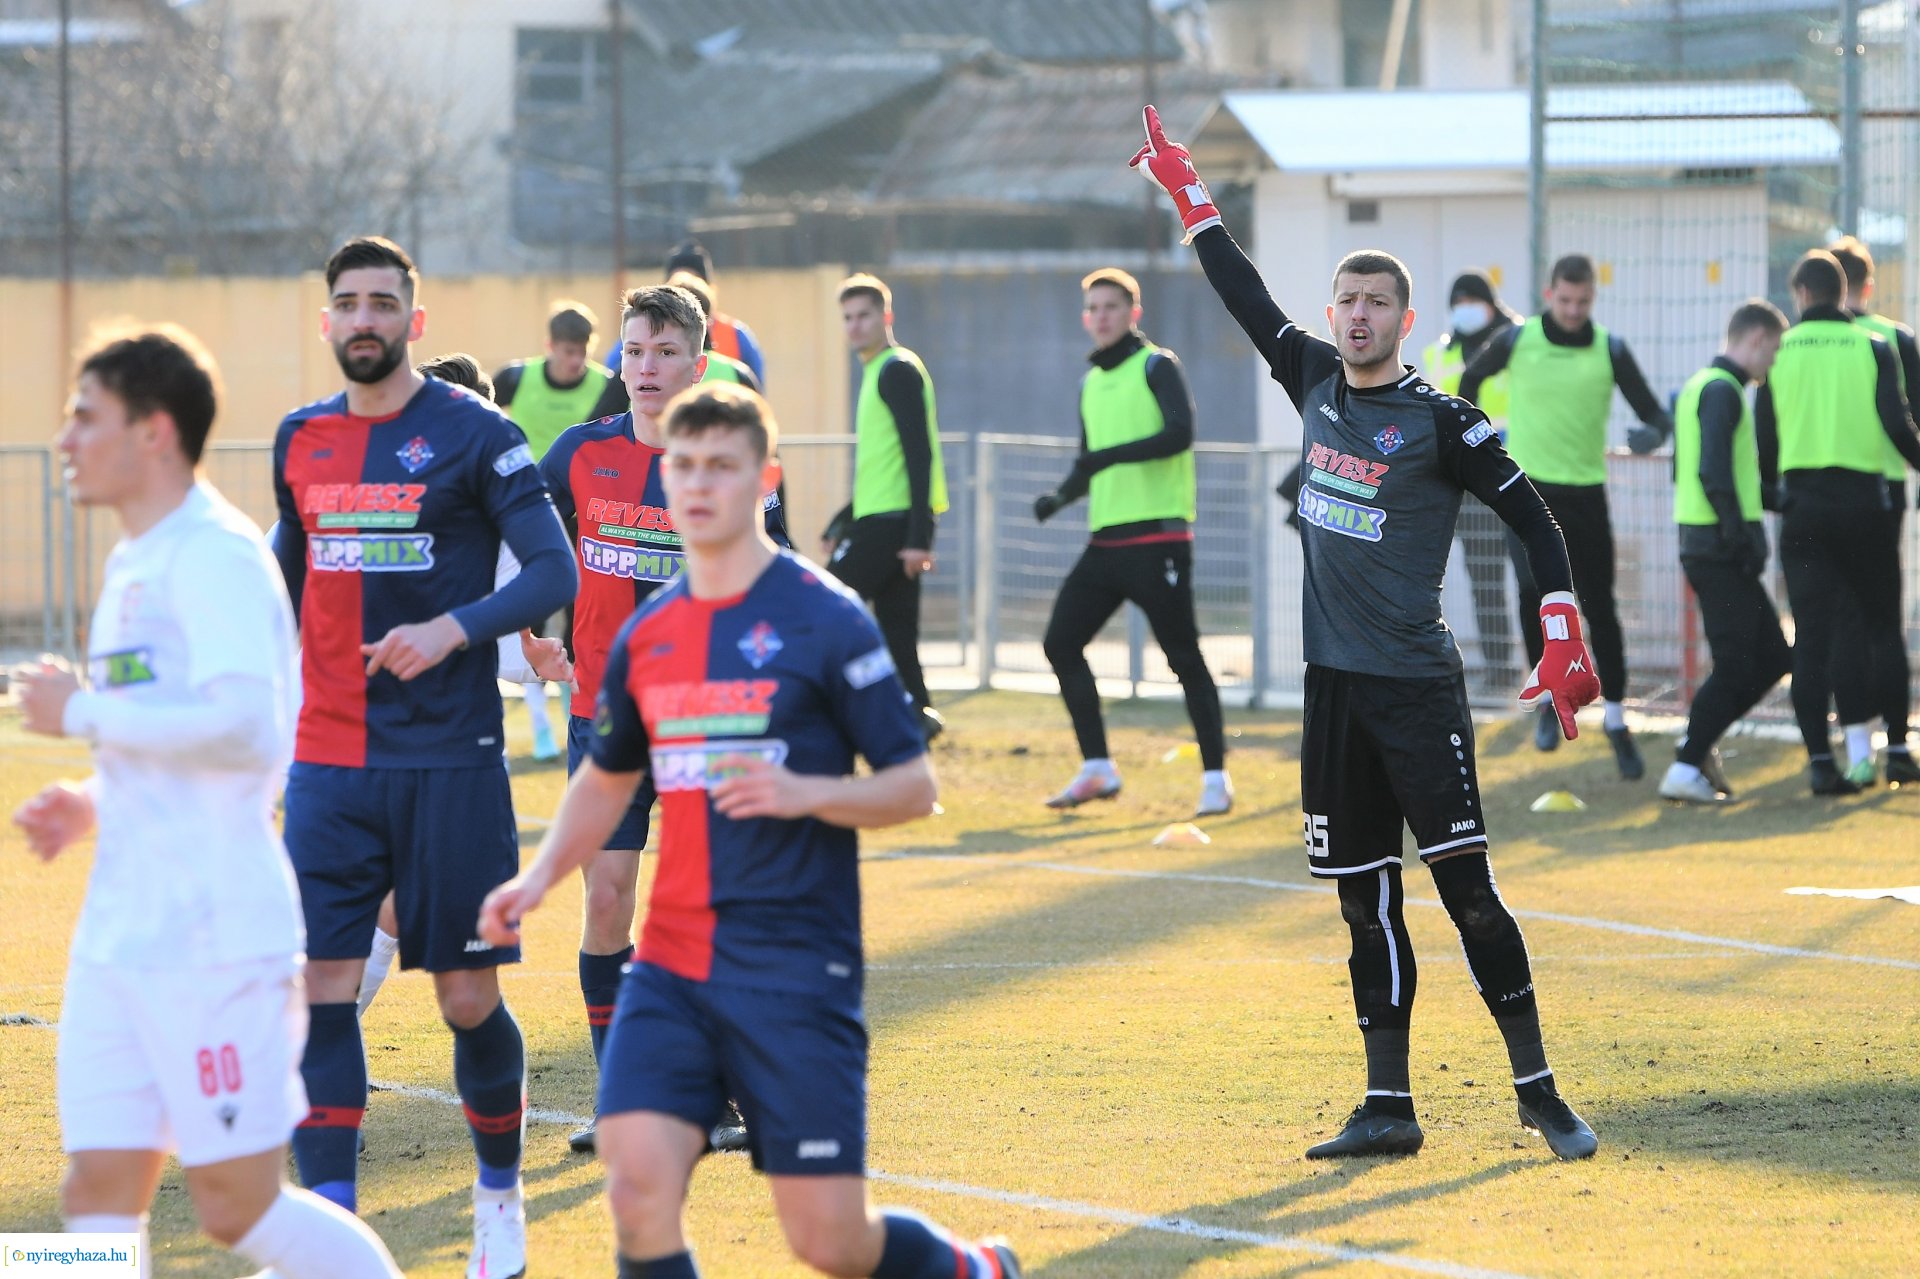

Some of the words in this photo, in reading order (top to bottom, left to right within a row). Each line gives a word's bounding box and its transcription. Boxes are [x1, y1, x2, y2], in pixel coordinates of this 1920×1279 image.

[1319, 403, 1340, 422] JAKO
[1306, 442, 1390, 487] REVESZ
[586, 498, 679, 532] REVES
[600, 527, 625, 536] ALWAYS
[650, 533, 672, 541] RIGHT
[1450, 819, 1476, 833] JAKO
[1500, 983, 1533, 1002] JAKO
[196, 1043, 242, 1097] 80
